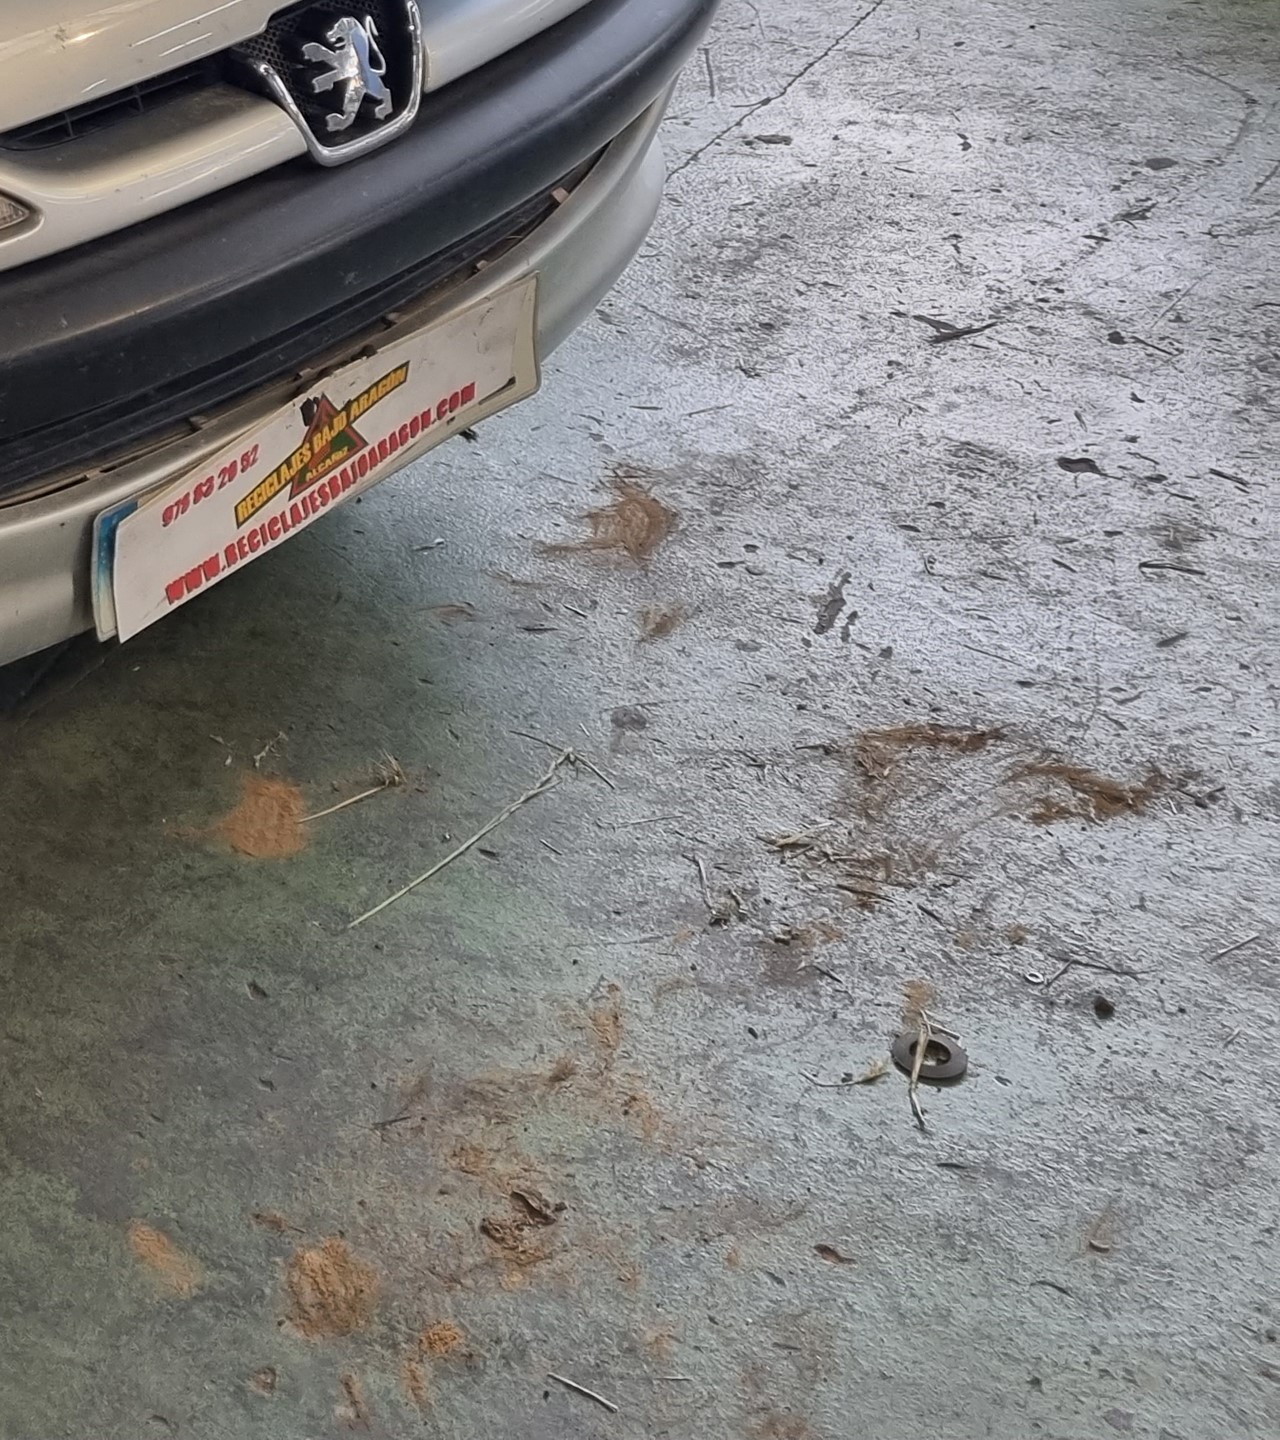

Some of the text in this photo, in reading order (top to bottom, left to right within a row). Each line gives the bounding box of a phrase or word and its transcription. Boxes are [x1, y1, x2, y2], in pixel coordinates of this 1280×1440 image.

[165, 381, 475, 606] WWW.RECICLAJESBAJOARAGON.COM
[218, 459, 238, 491] 20
[237, 442, 313, 521] RECICLAJES
[312, 411, 348, 454] BAJO
